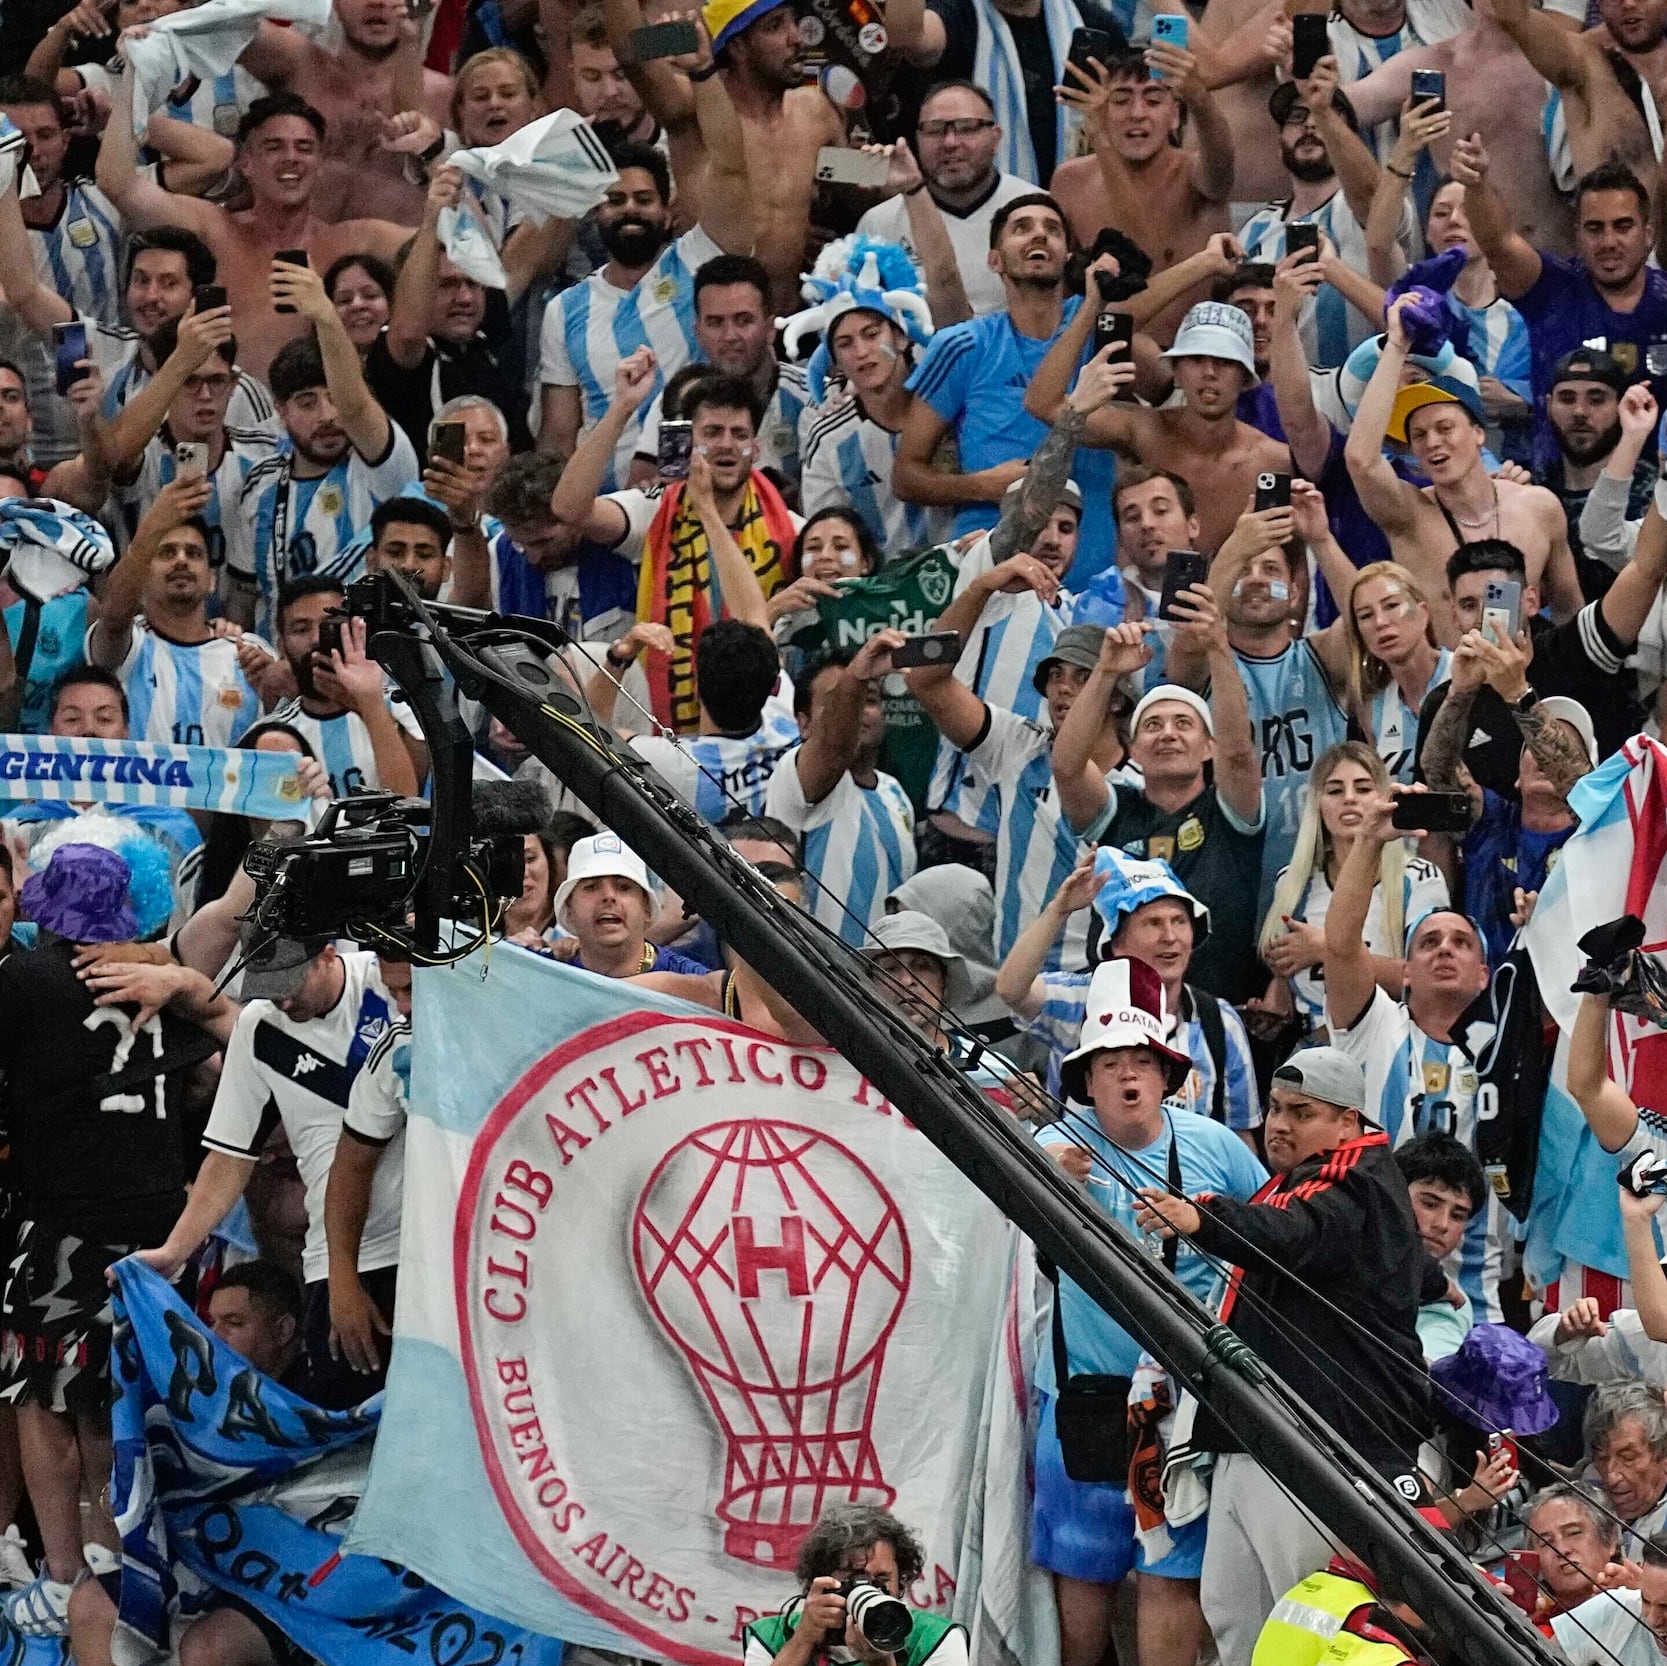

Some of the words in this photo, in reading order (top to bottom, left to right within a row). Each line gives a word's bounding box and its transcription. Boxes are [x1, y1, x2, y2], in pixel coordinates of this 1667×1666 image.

[485, 1155, 556, 1325] CLUB
[546, 1034, 828, 1168] ATLETICO
[731, 1215, 812, 1299] H
[495, 1357, 582, 1533] BUENOS
[574, 1534, 694, 1624] AIRES
